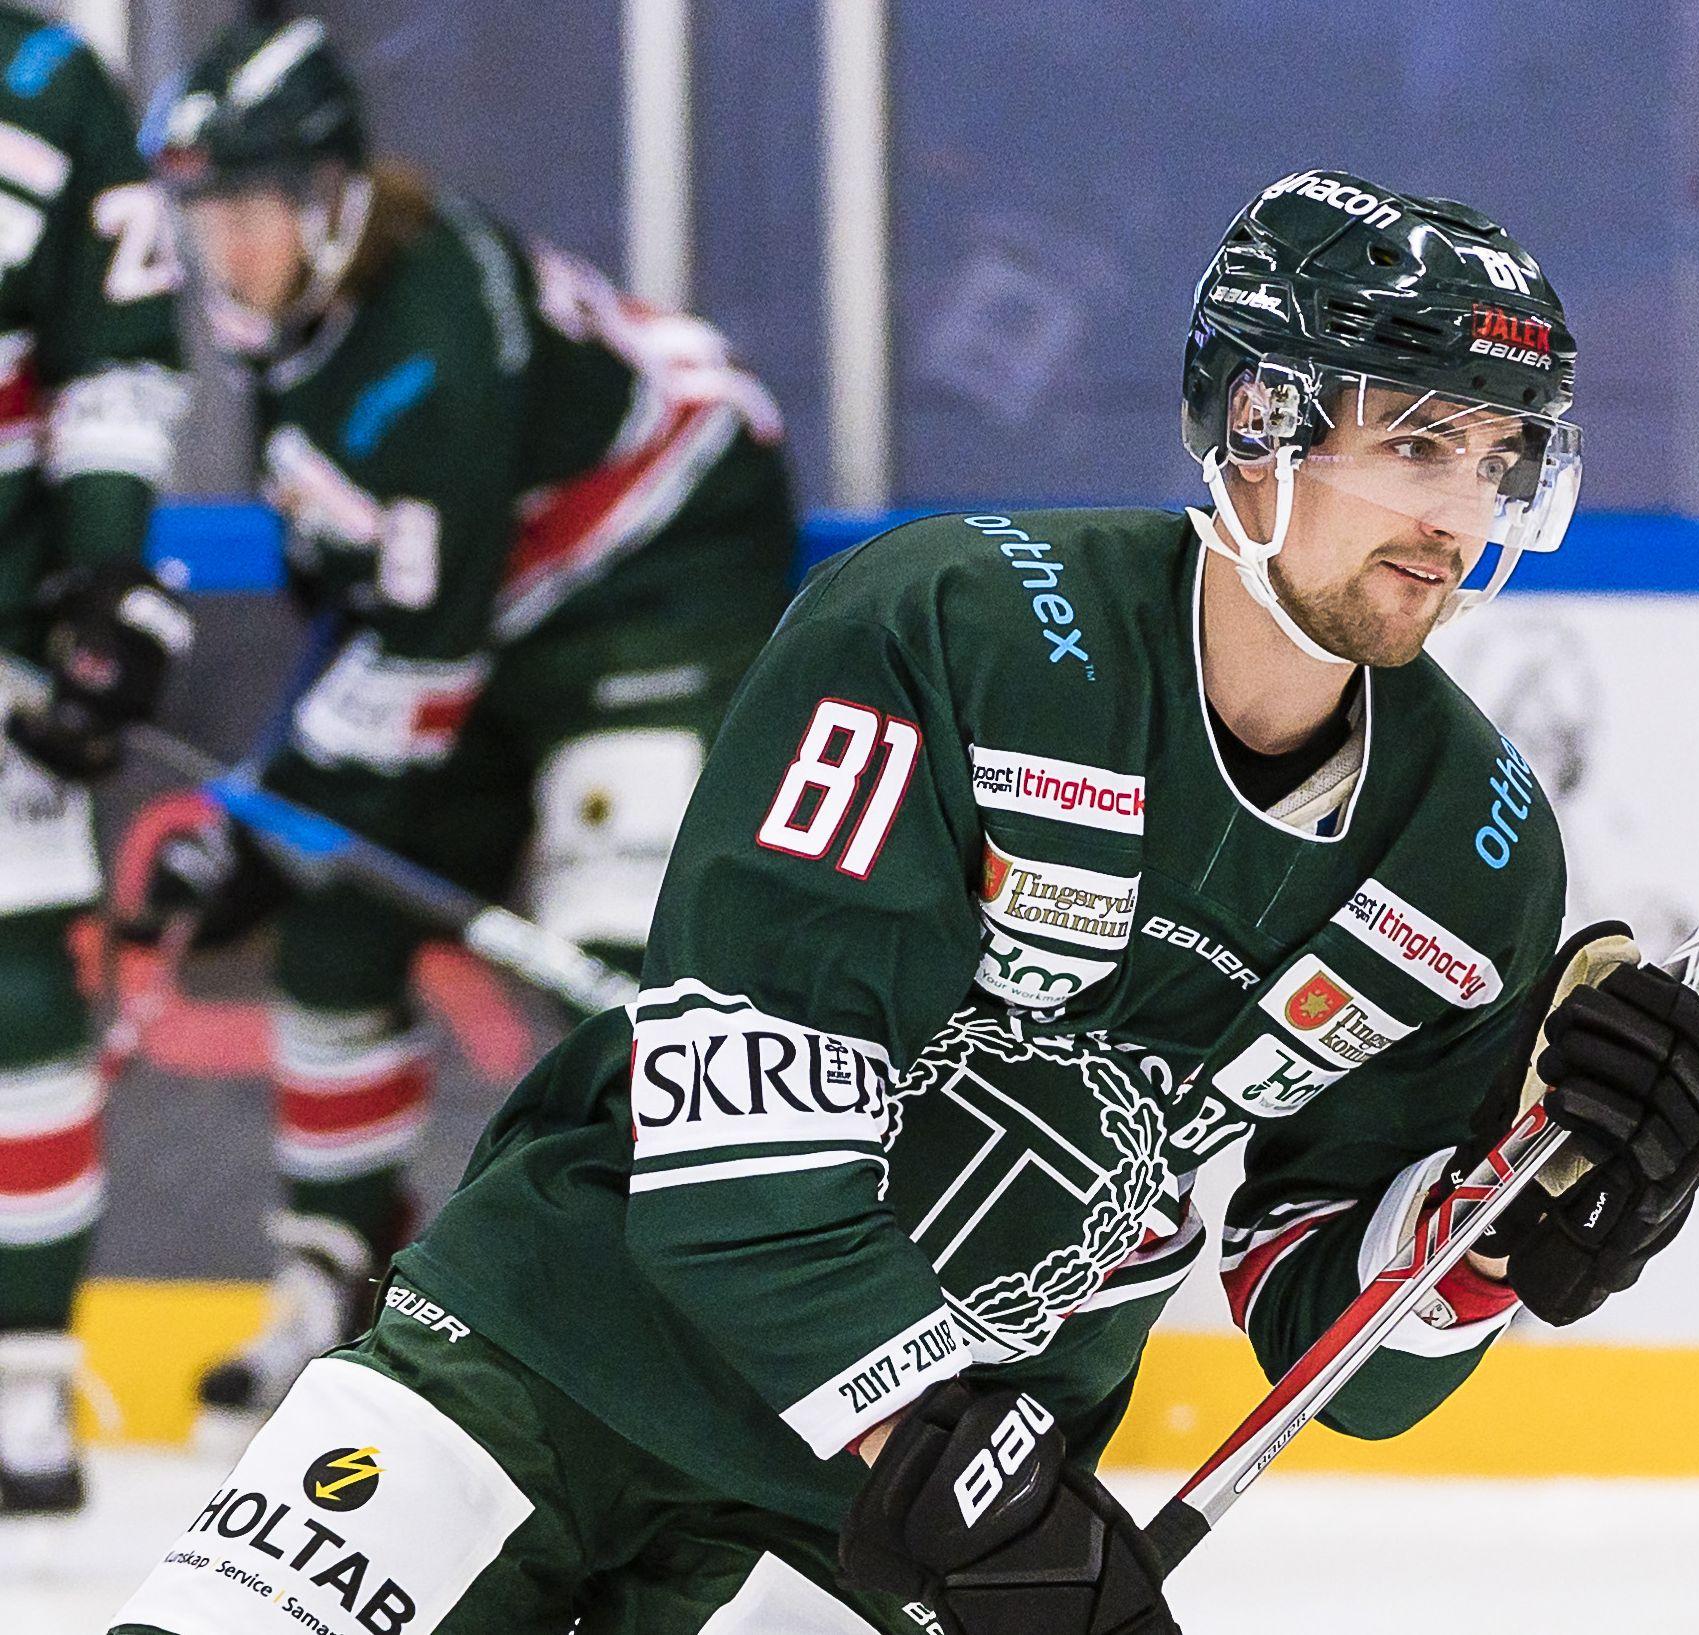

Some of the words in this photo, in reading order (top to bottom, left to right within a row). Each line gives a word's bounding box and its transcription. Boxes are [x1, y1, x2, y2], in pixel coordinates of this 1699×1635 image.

[1469, 338, 1552, 371] BAUER
[755, 697, 924, 882] 81
[973, 764, 1014, 783] port
[1141, 916, 1261, 990] BAUER
[838, 1318, 958, 1414] 2017-2018
[187, 1488, 417, 1635] HOLTAB
[215, 1560, 273, 1598] Service
